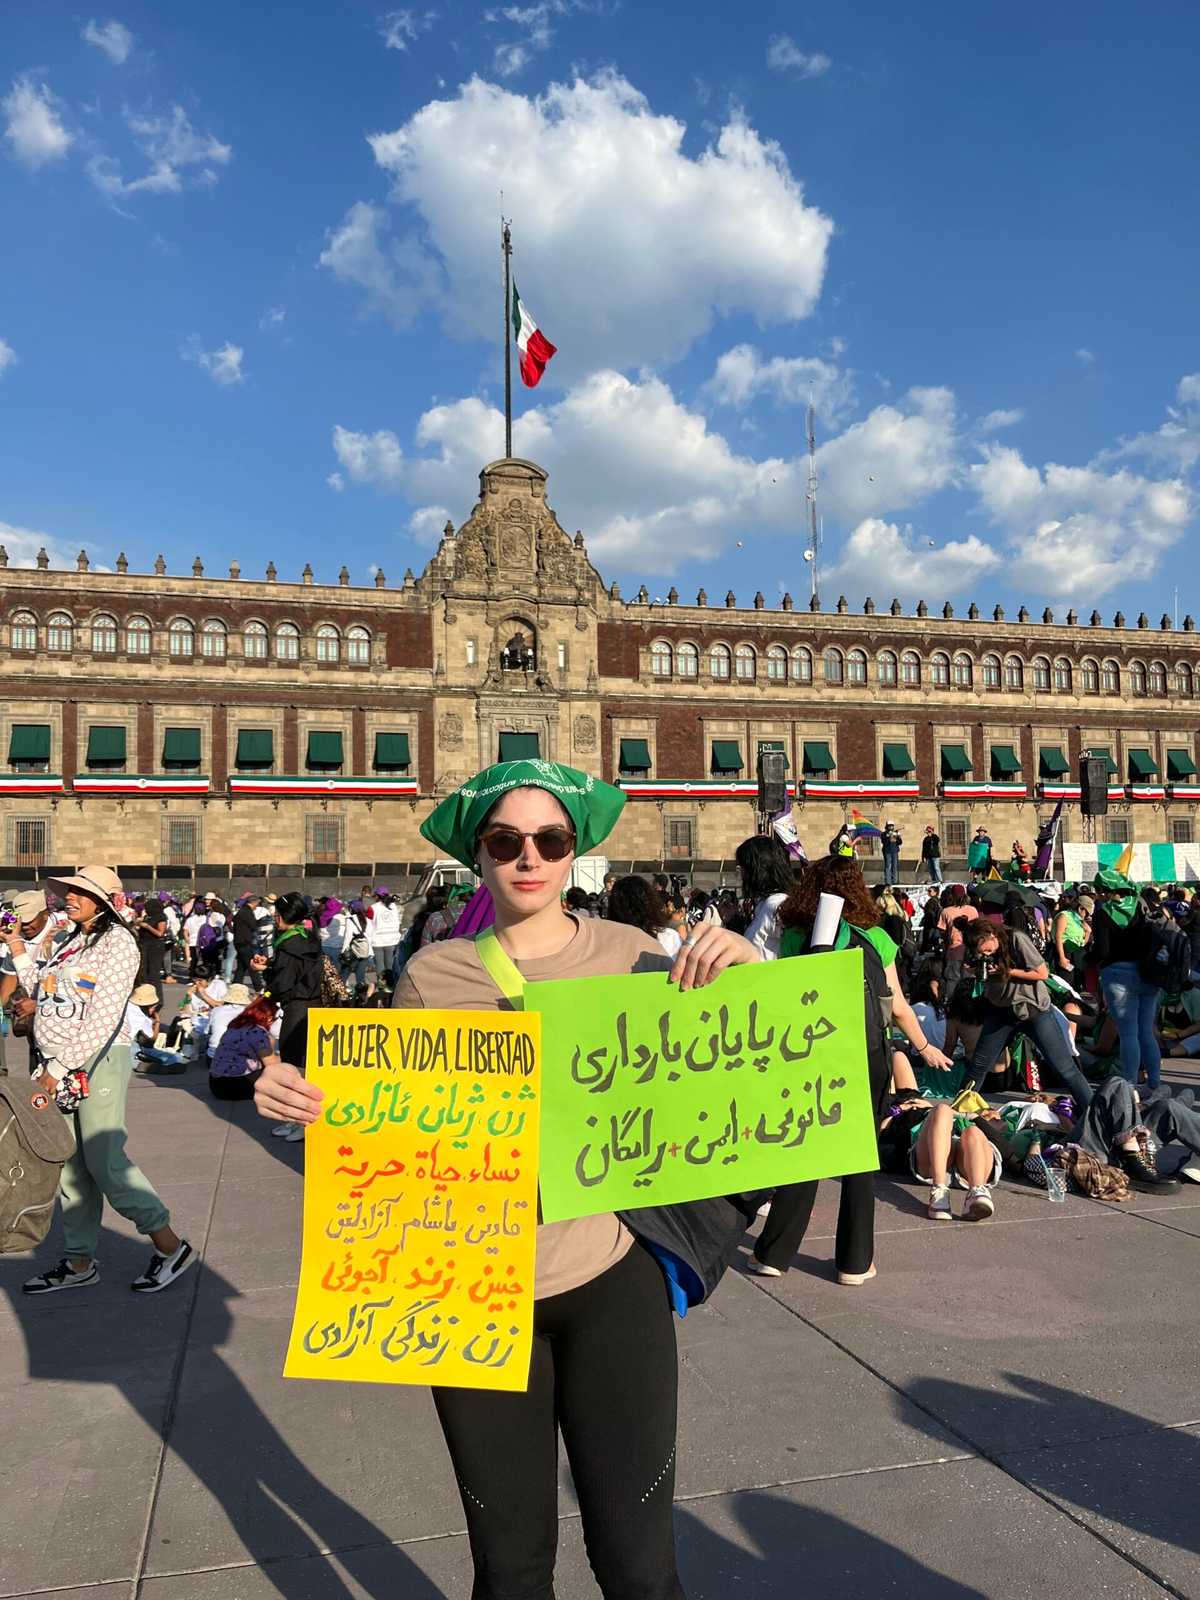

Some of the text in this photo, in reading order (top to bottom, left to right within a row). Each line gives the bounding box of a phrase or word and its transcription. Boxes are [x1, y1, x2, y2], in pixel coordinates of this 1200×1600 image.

[317, 1024, 535, 1077] MUJER, VIDA, LIBERTAD
[571, 990, 837, 1094] حق پایان بارداری
[684, 1097, 738, 1165] ایمن
[754, 1074, 846, 1148] قانونی
[575, 1106, 667, 1188] رایگان
[303, 1296, 394, 1359] آزادی
